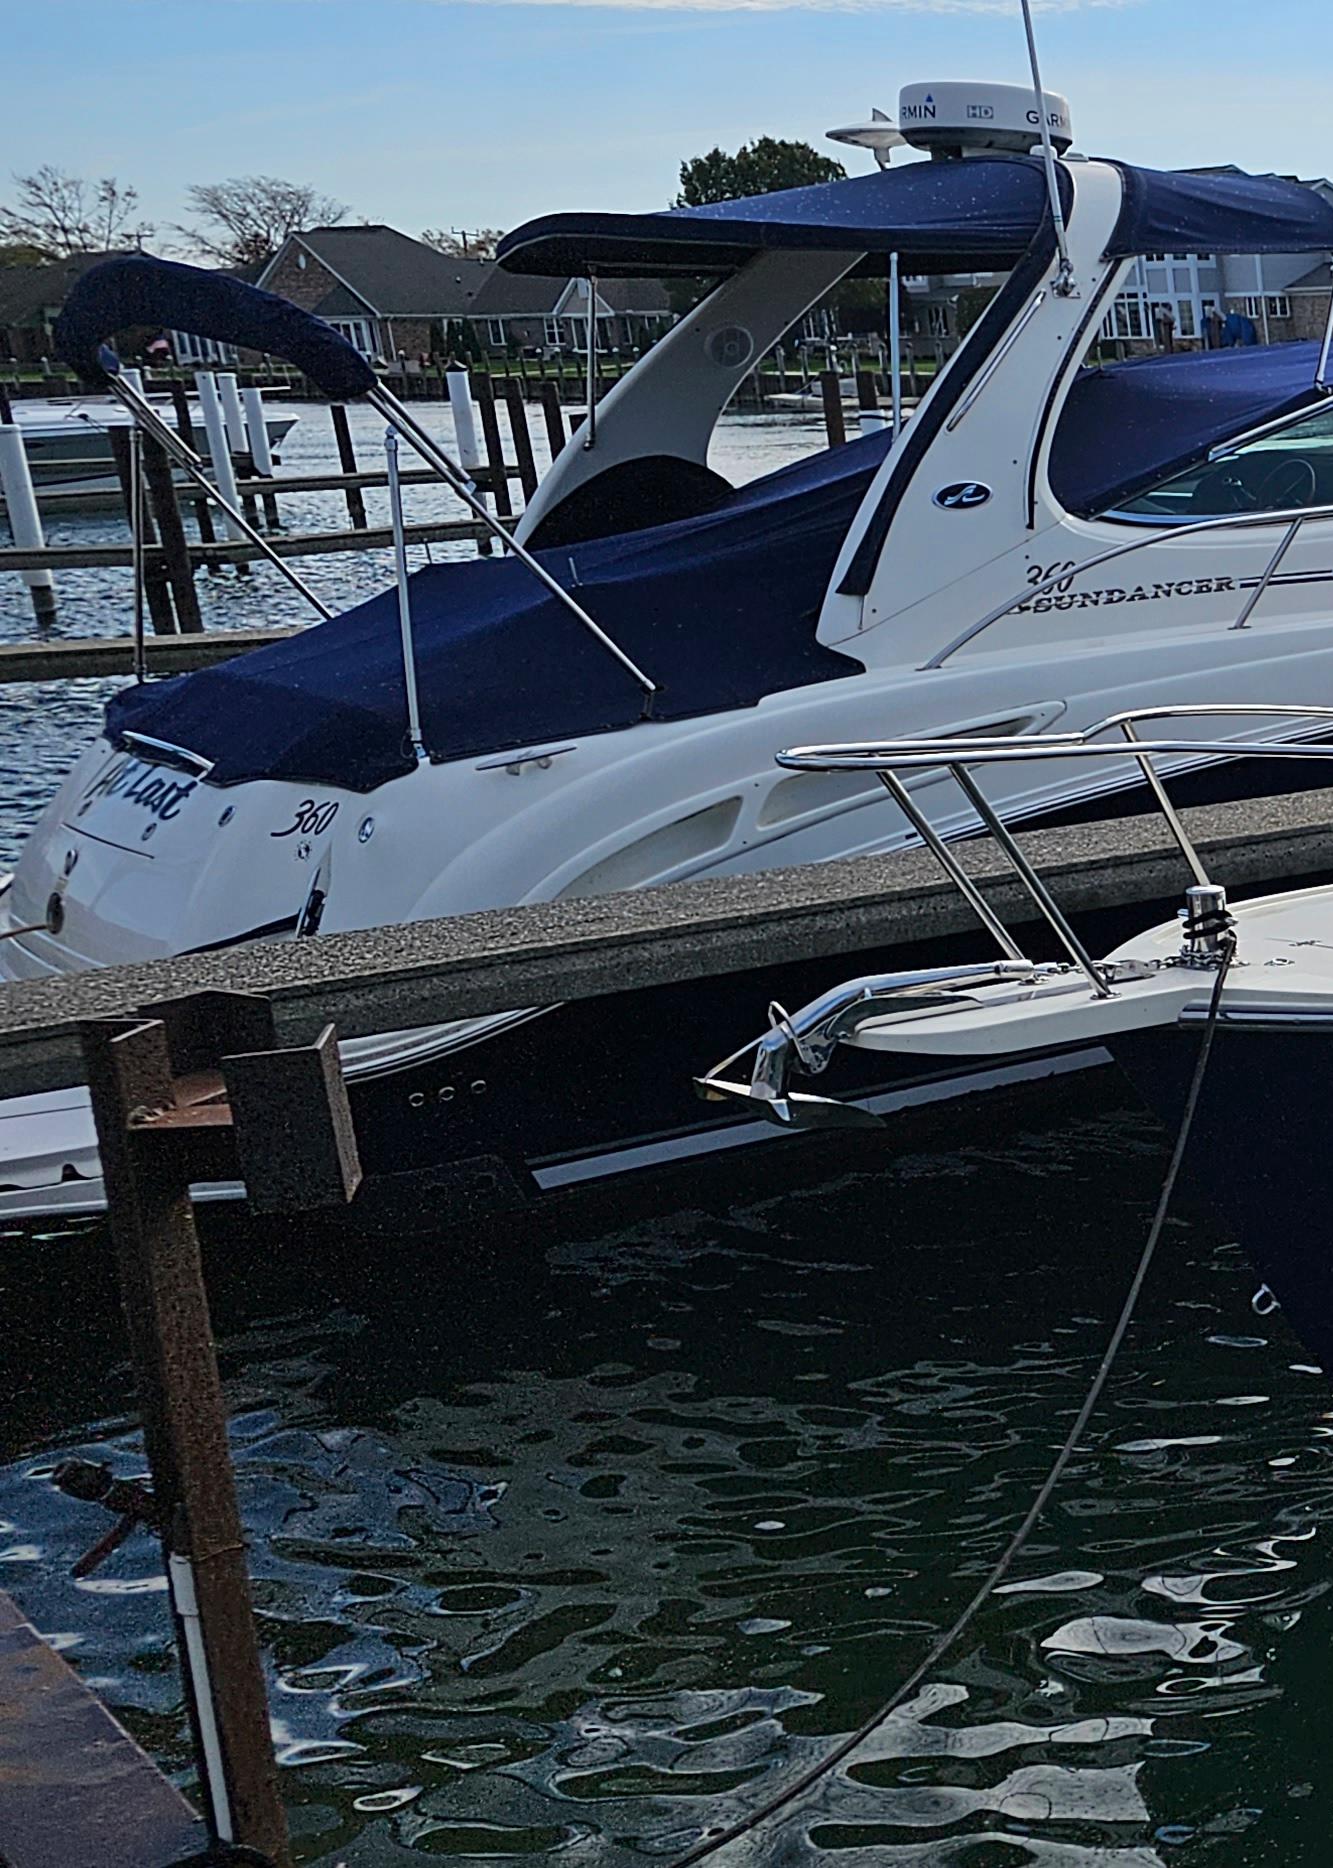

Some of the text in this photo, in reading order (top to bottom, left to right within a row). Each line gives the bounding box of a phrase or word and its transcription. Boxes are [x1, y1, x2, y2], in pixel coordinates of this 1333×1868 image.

[967, 105, 994, 120] HD
[1026, 561, 1076, 595] 360
[1032, 576, 1236, 614] SUNDANCER
[123, 764, 198, 821] Last
[269, 799, 340, 837] 360
